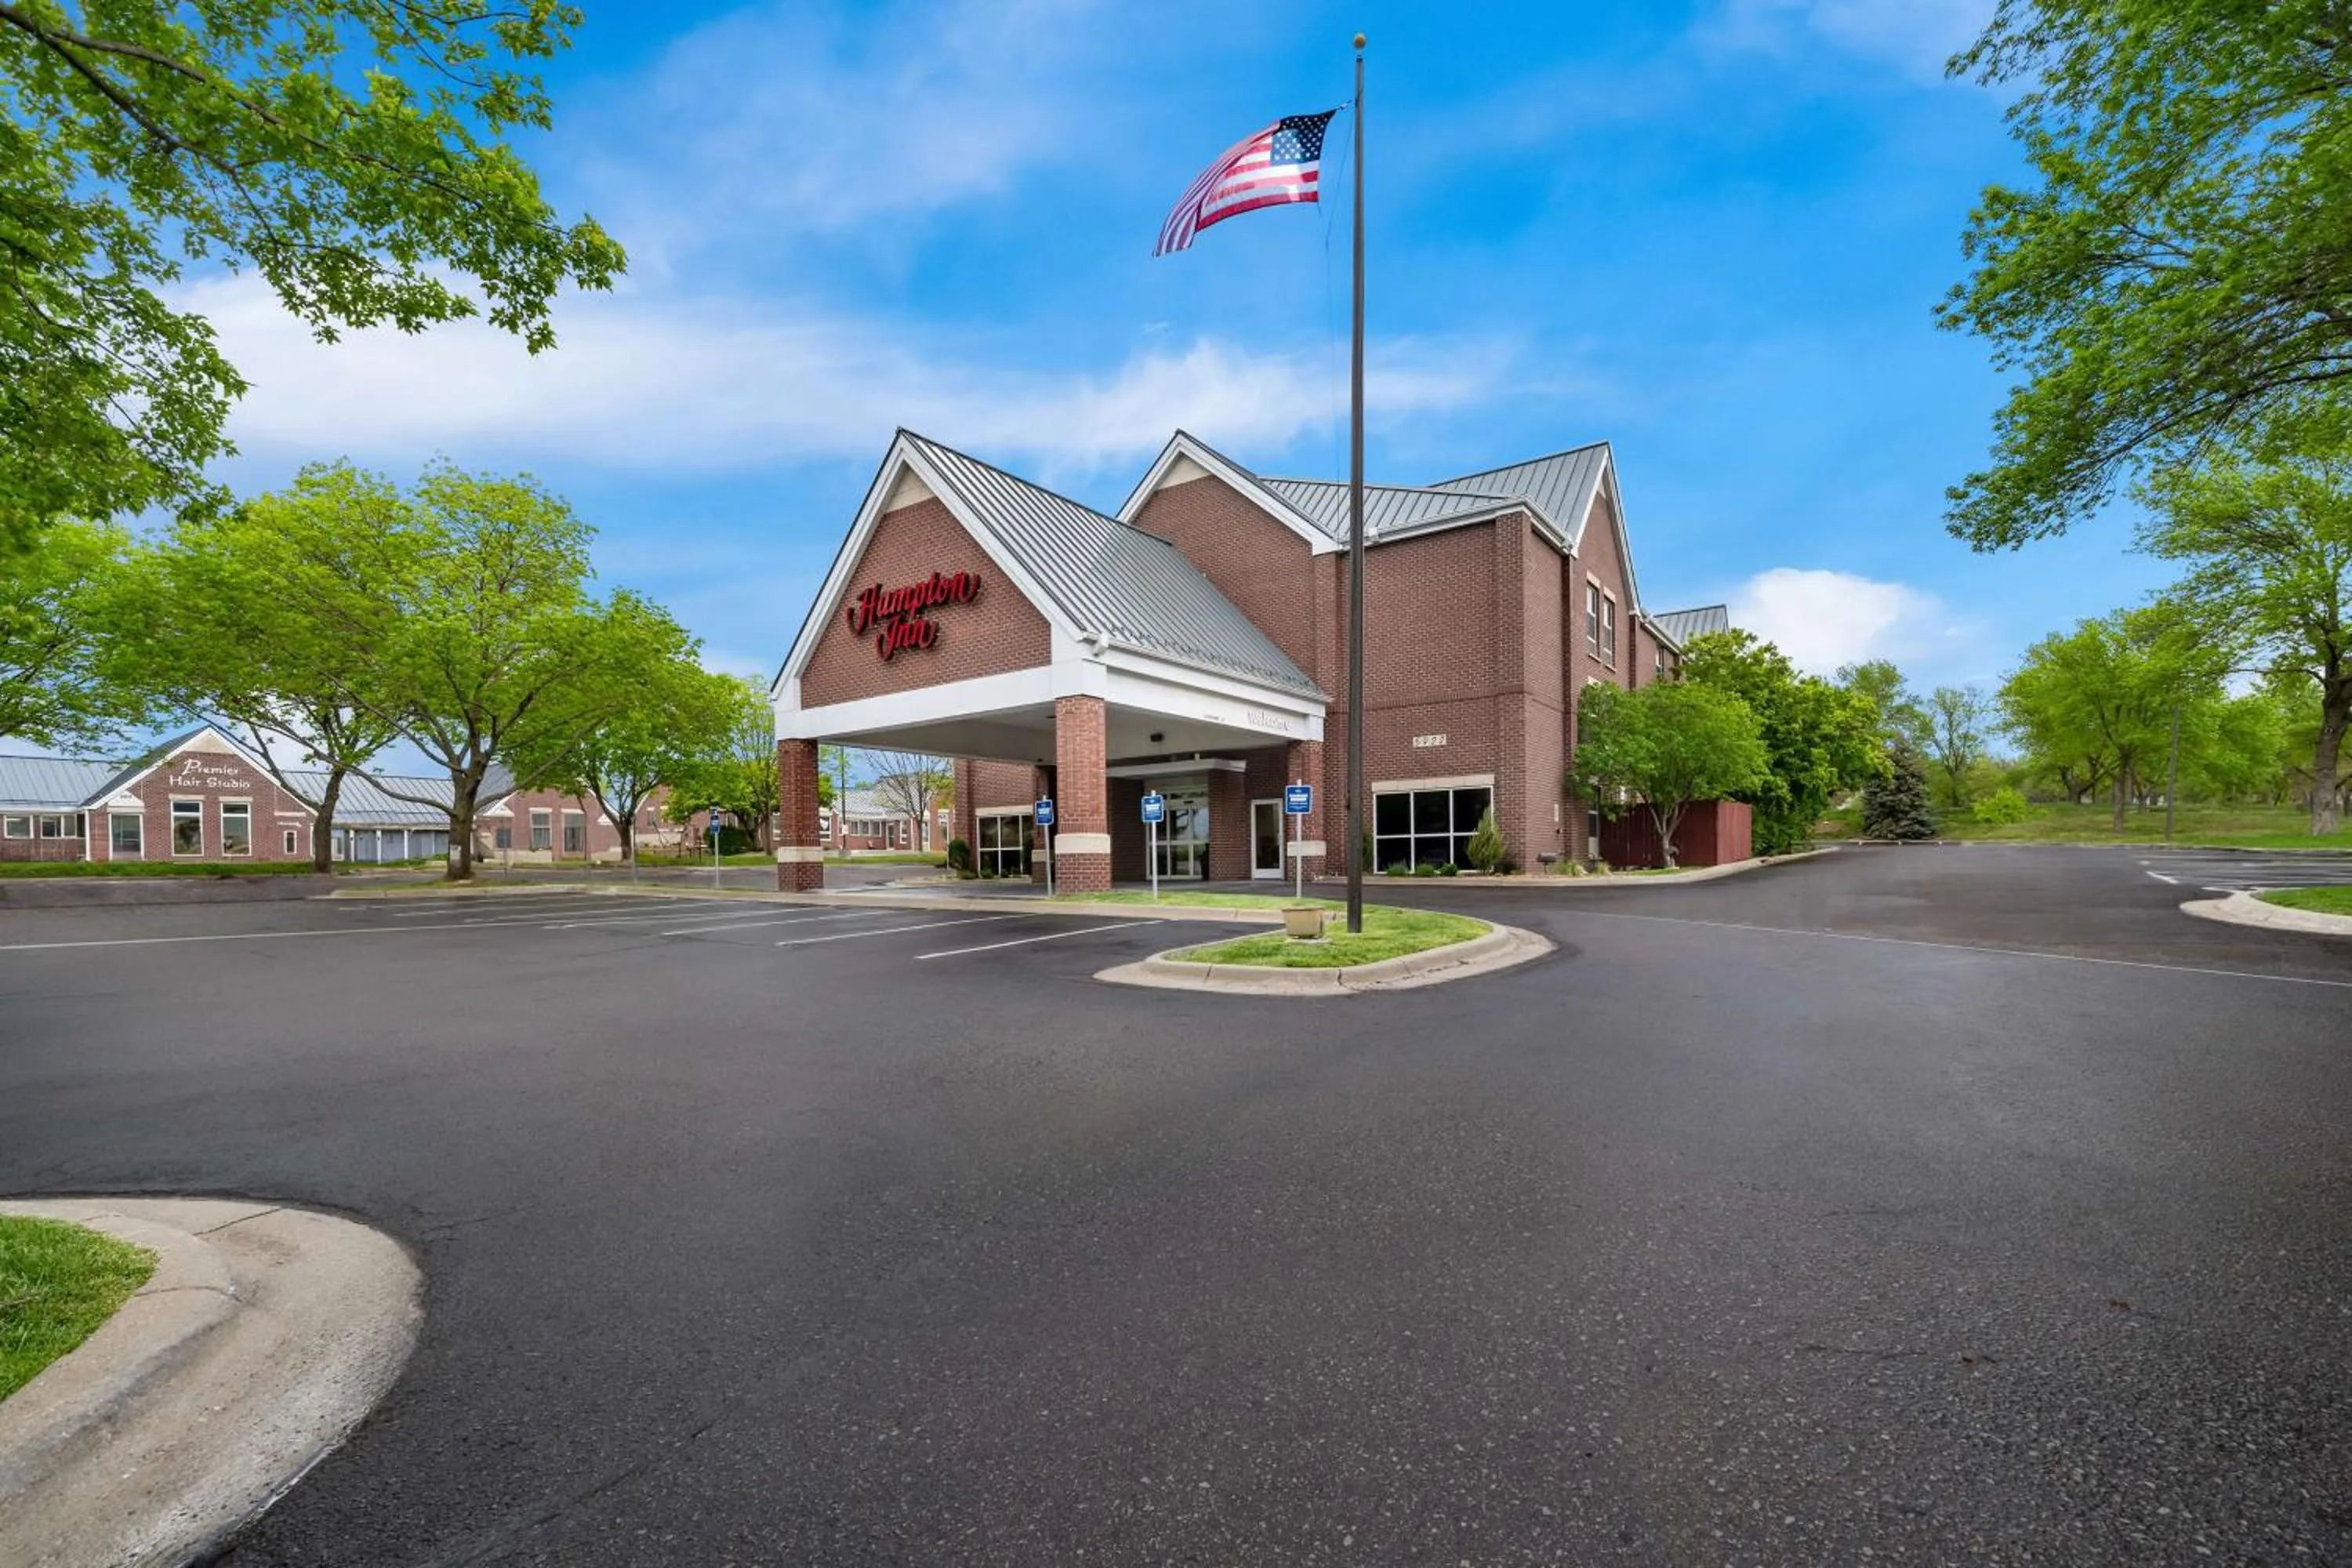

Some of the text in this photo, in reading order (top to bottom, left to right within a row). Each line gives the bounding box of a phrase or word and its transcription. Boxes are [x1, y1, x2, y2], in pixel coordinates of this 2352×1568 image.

[845, 570, 981, 636] Hampton
[876, 615, 939, 661] Inn
[169, 775, 251, 789] Hair Studio
[181, 758, 238, 775] Premier
